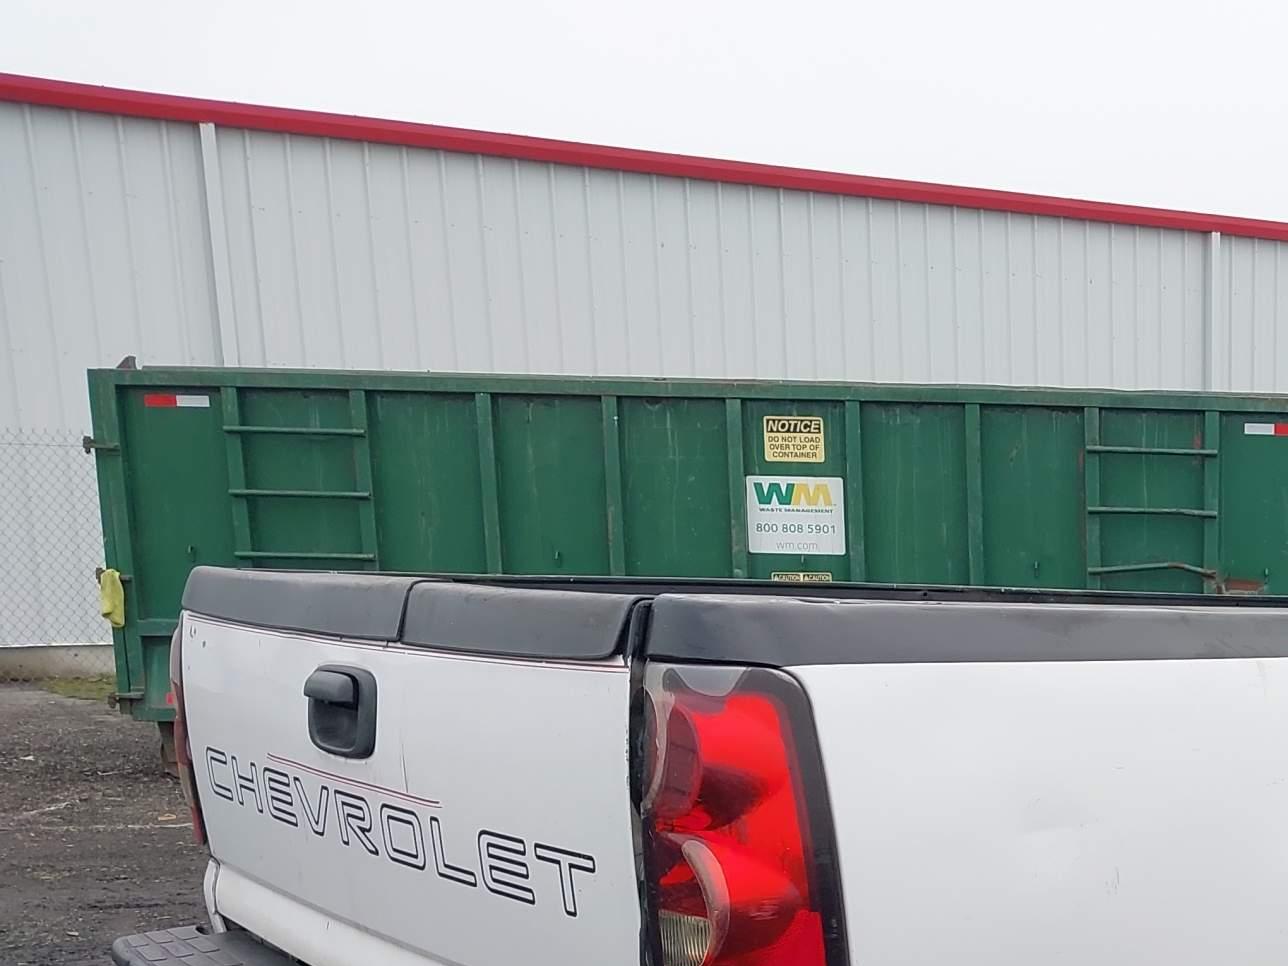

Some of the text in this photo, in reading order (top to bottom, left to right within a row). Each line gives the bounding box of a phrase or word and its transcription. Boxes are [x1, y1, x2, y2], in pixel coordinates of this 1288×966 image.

[767, 420, 820, 432] NOTICE
[768, 435, 821, 444] DO NOT LOAD
[769, 443, 790, 451] OVER
[791, 443, 808, 451] TOP
[772, 451, 817, 459] CONTAINER
[753, 482, 832, 507] WM
[756, 522, 836, 534] 800 808 5901
[205, 746, 597, 918] CHEVROLET
